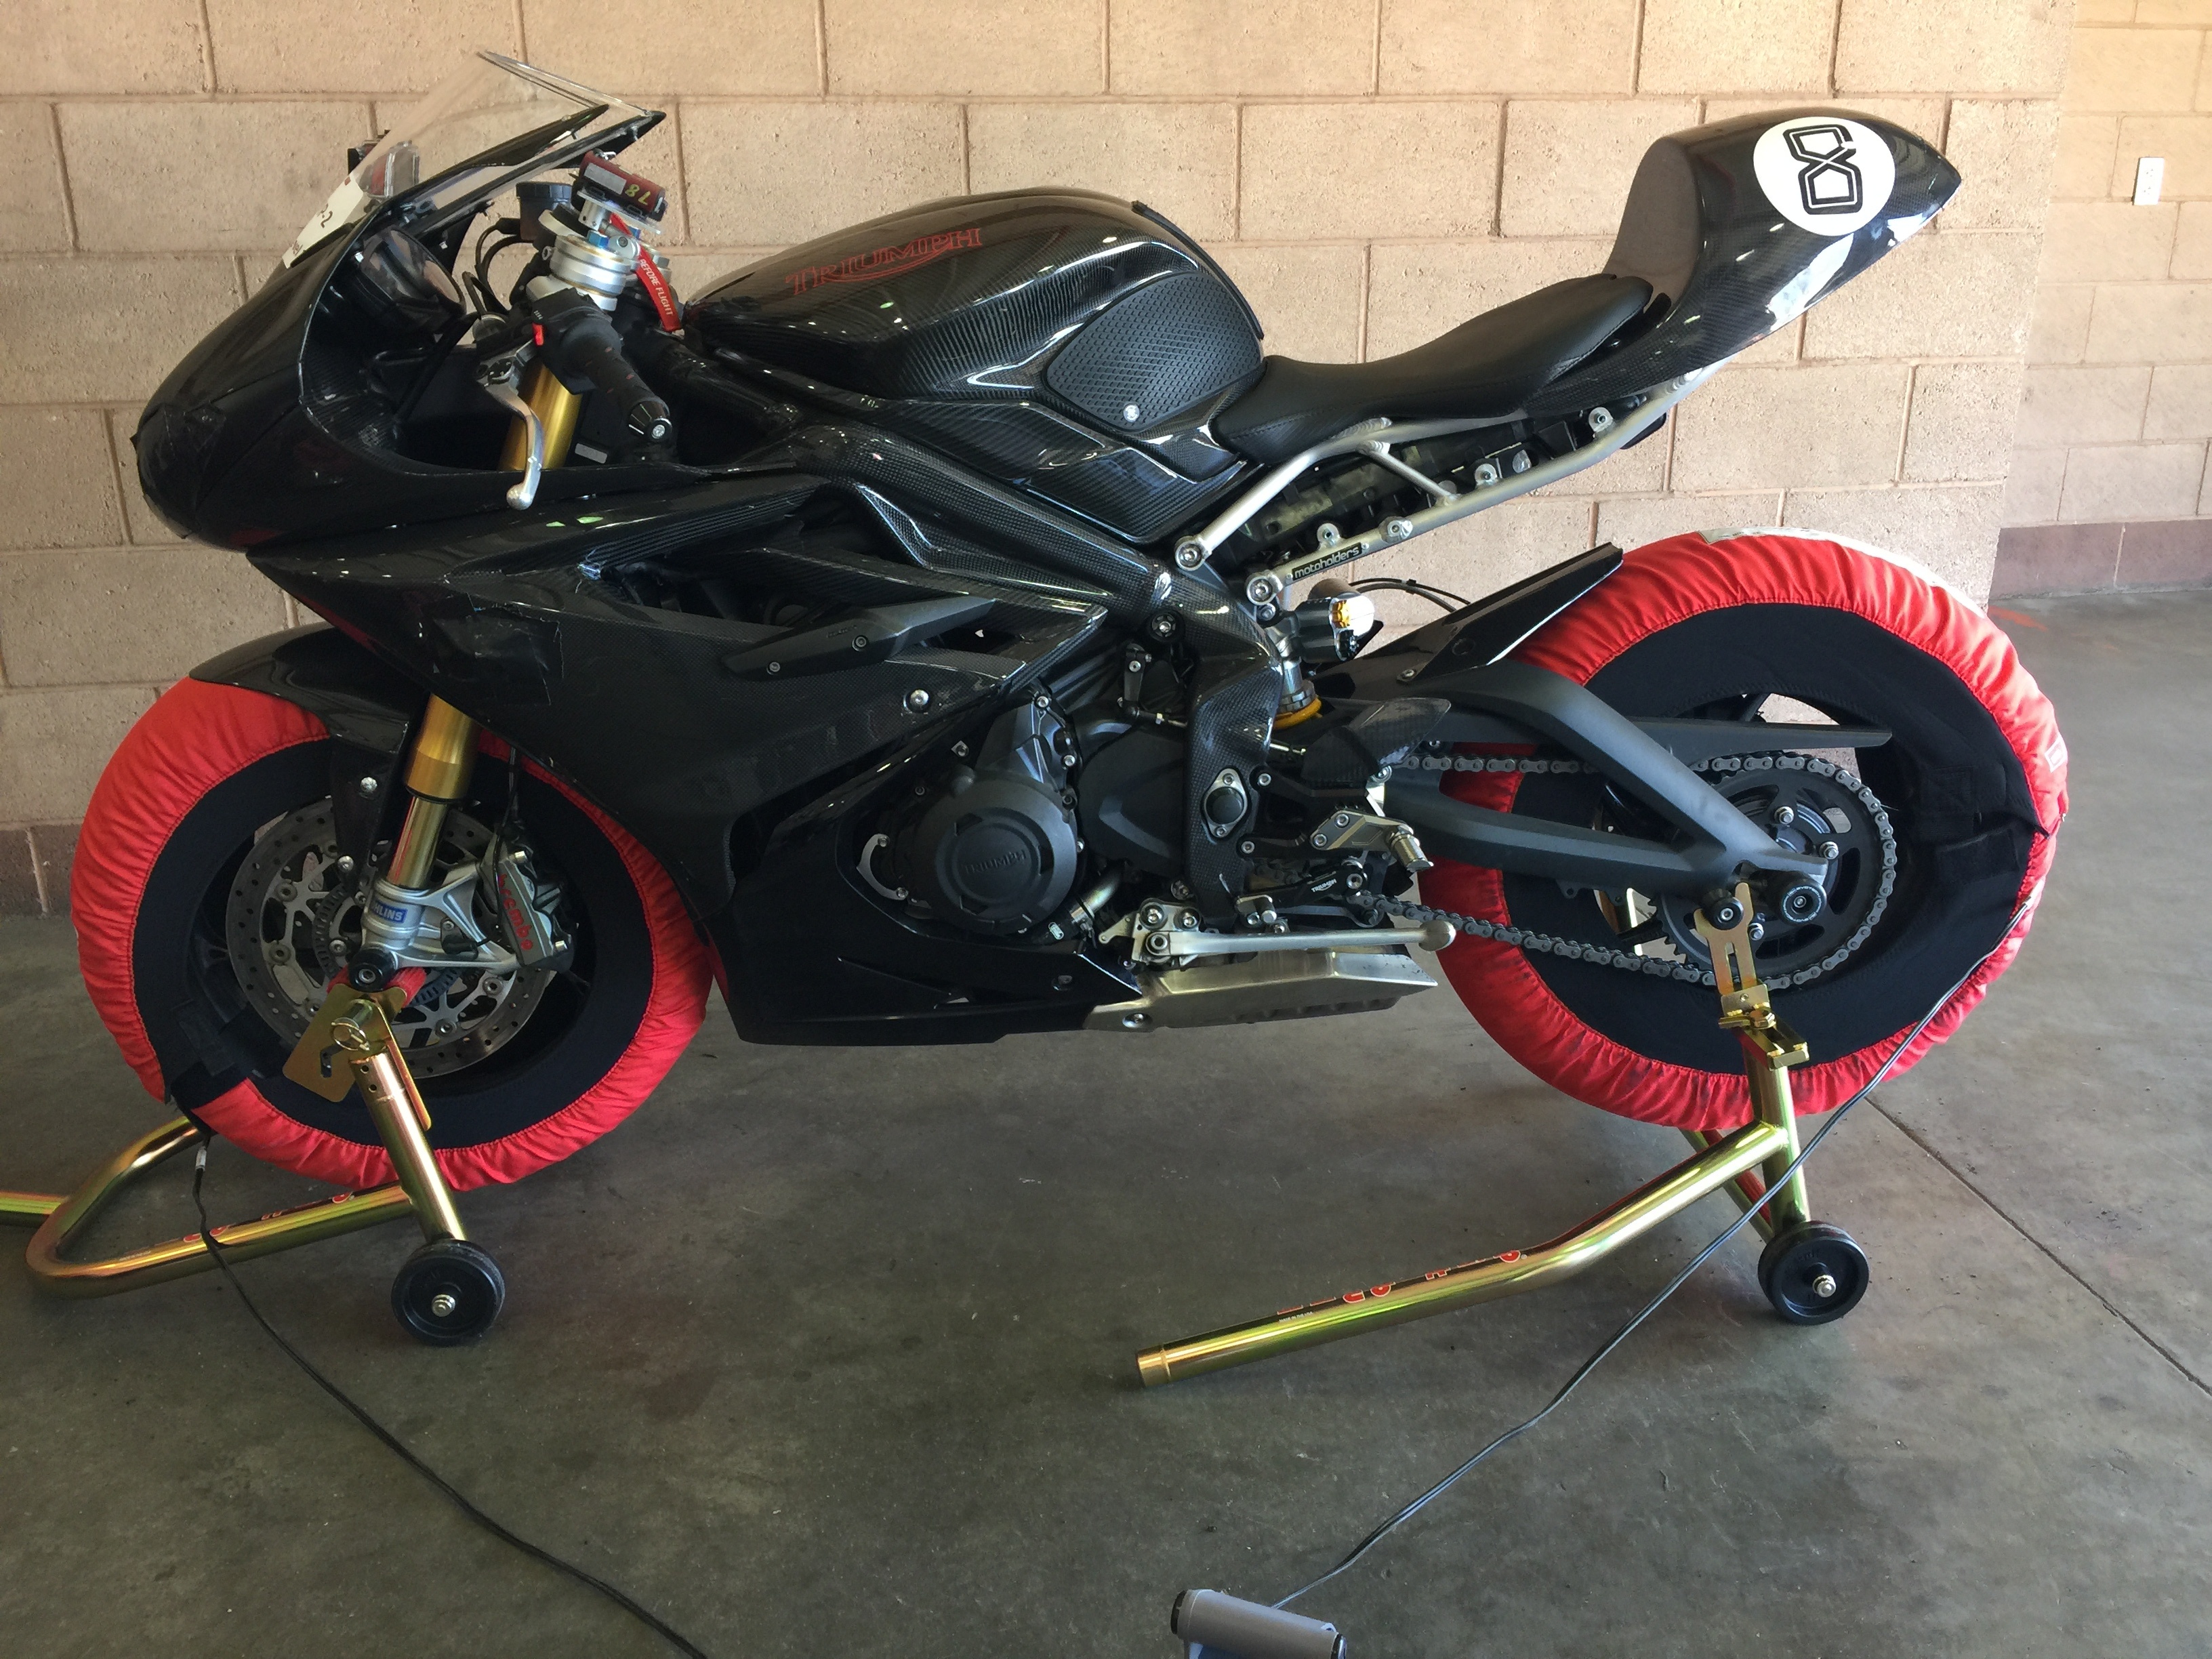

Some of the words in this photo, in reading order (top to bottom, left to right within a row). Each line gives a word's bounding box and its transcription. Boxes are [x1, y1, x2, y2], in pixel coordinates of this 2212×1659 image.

[1782, 123, 1863, 216] 8
[785, 228, 982, 295] TRIUMPH
[655, 287, 674, 316] FLIGHT
[1294, 546, 1359, 579] motoholders
